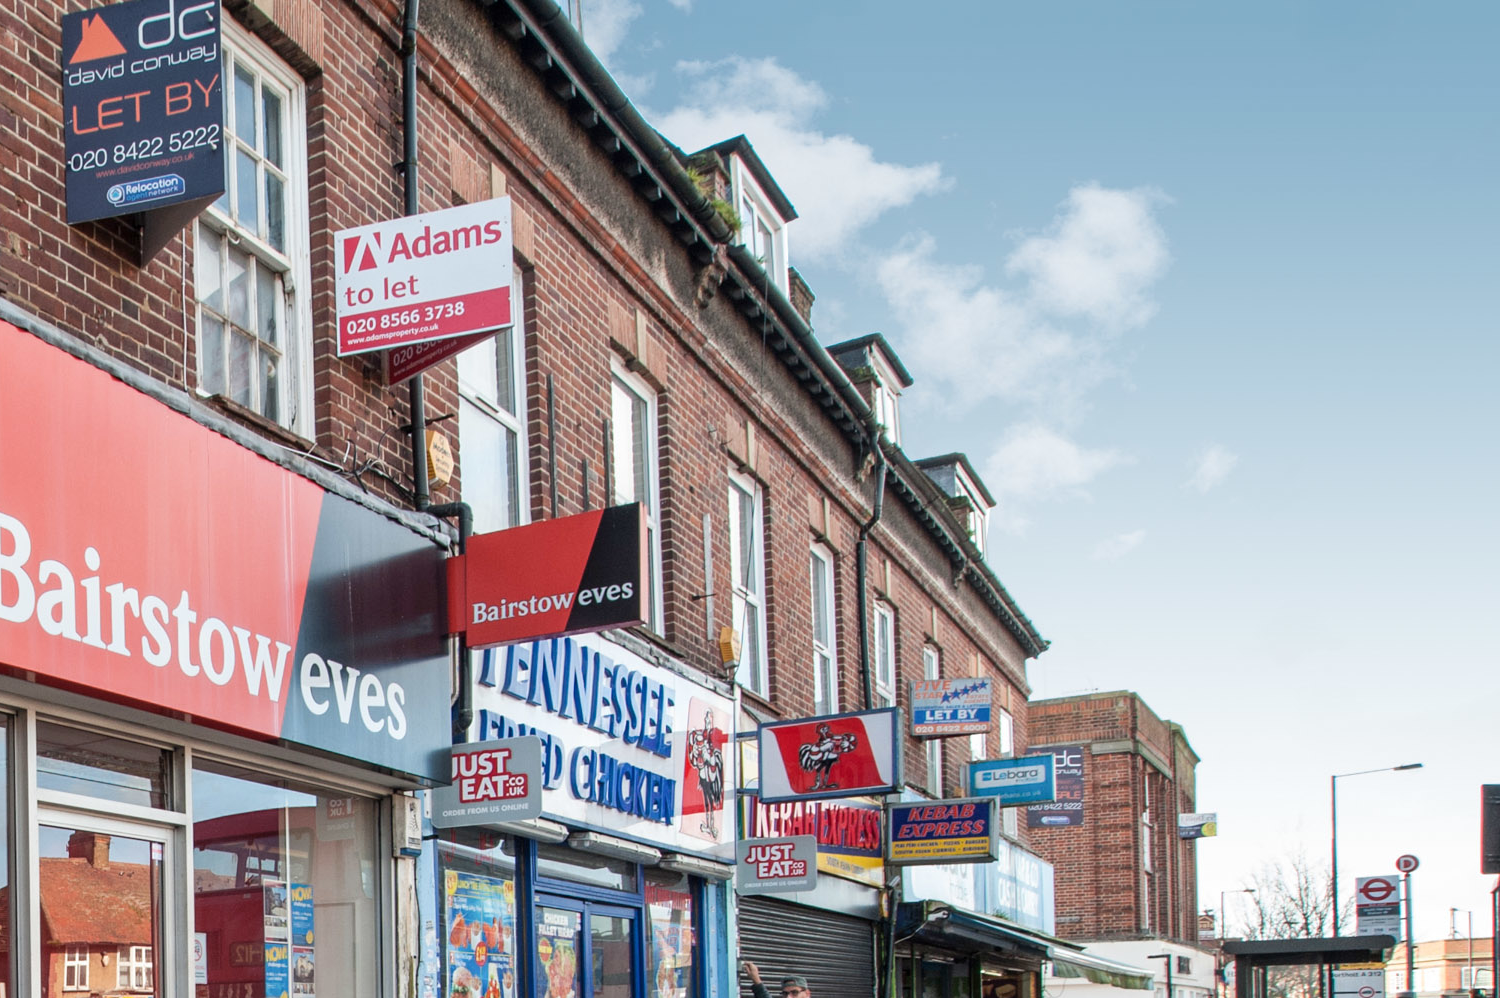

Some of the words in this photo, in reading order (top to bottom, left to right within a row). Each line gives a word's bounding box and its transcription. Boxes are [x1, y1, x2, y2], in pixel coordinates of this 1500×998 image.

[138, 0, 216, 49] dc
[68, 59, 125, 87] david
[130, 42, 217, 74] conway
[72, 90, 151, 135] LET
[165, 73, 219, 116] BY
[70, 148, 108, 172] 020
[113, 136, 164, 164] 8422
[169, 123, 220, 153] 5222
[96, 153, 195, 178] www.davidconway.co.uk
[126, 177, 179, 194] Relocation
[388, 220, 502, 264] Adams
[345, 286, 374, 307] to
[383, 275, 420, 300] let
[347, 316, 377, 335] 020
[380, 309, 420, 329] 8566
[424, 301, 465, 322] 3738
[347, 324, 439, 346] www.adamsproperty.co.uk
[393, 347, 414, 367] 020
[472, 591, 575, 625] Bairstow
[577, 581, 634, 607] eves
[300, 652, 408, 740] eves
[915, 680, 952, 691] FIVE
[478, 636, 676, 760] TENNESSEE
[925, 709, 953, 721] LET
[958, 708, 978, 720] BY
[915, 725, 934, 733] 020
[570, 746, 677, 826] CHICKEN
[993, 769, 1039, 781] Lebara
[462, 775, 507, 801] EAT
[442, 808, 466, 818] ORDER
[467, 807, 488, 815] FROM
[489, 806, 500, 814] US
[501, 803, 529, 812] ONLINE
[907, 803, 976, 822] KEBAB
[756, 801, 816, 839] KEBAB
[816, 802, 880, 849] EXPRESS
[898, 820, 985, 839] EXPRESS
[747, 844, 793, 863] JUST
[759, 861, 792, 878] EAT
[291, 886, 313, 902] NOW!
[266, 946, 288, 962] NOW!
